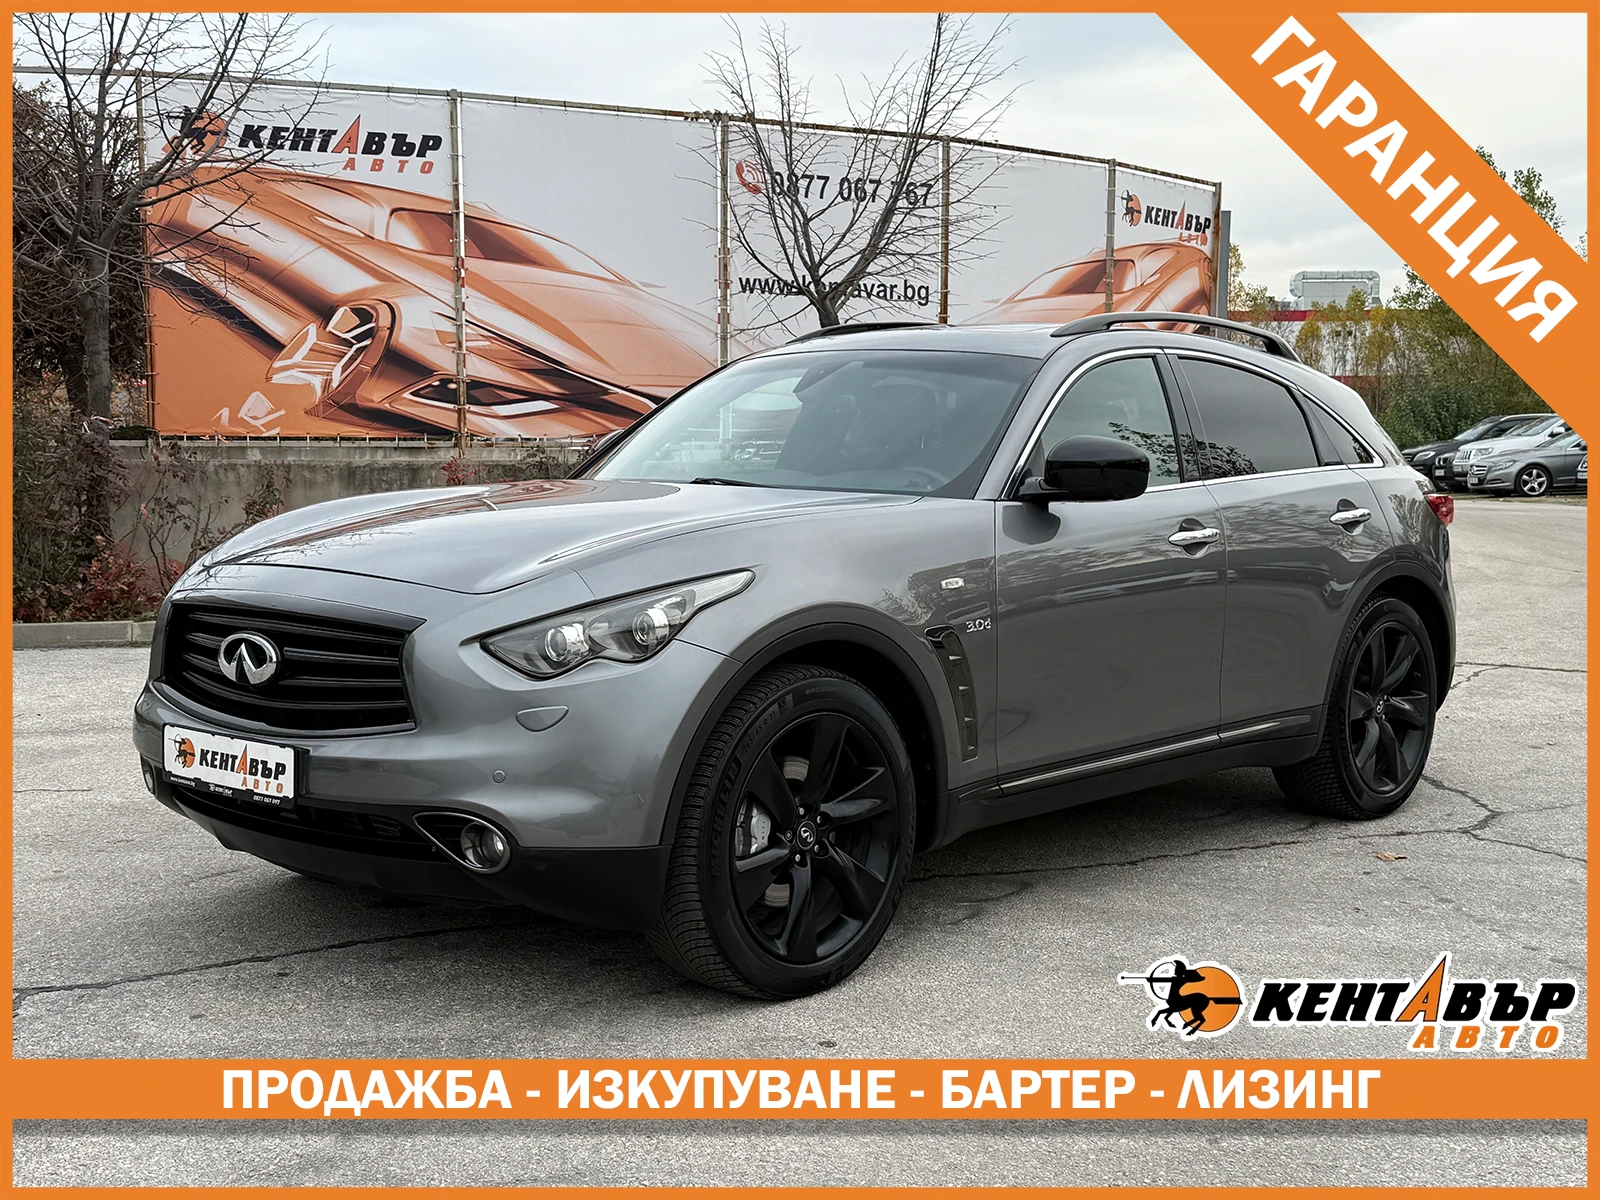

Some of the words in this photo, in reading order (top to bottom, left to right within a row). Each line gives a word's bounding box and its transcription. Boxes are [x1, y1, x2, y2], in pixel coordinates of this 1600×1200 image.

[238, 114, 443, 158] КЕНТАВЪР
[342, 157, 435, 175] АВТО
[839, 176, 882, 203] 067
[1144, 200, 1212, 234] КЕНТАВЪР
[199, 743, 287, 781] КЕНТАВЪР
[241, 776, 284, 794] АВТО
[711, 759, 740, 877] MICHELIN
